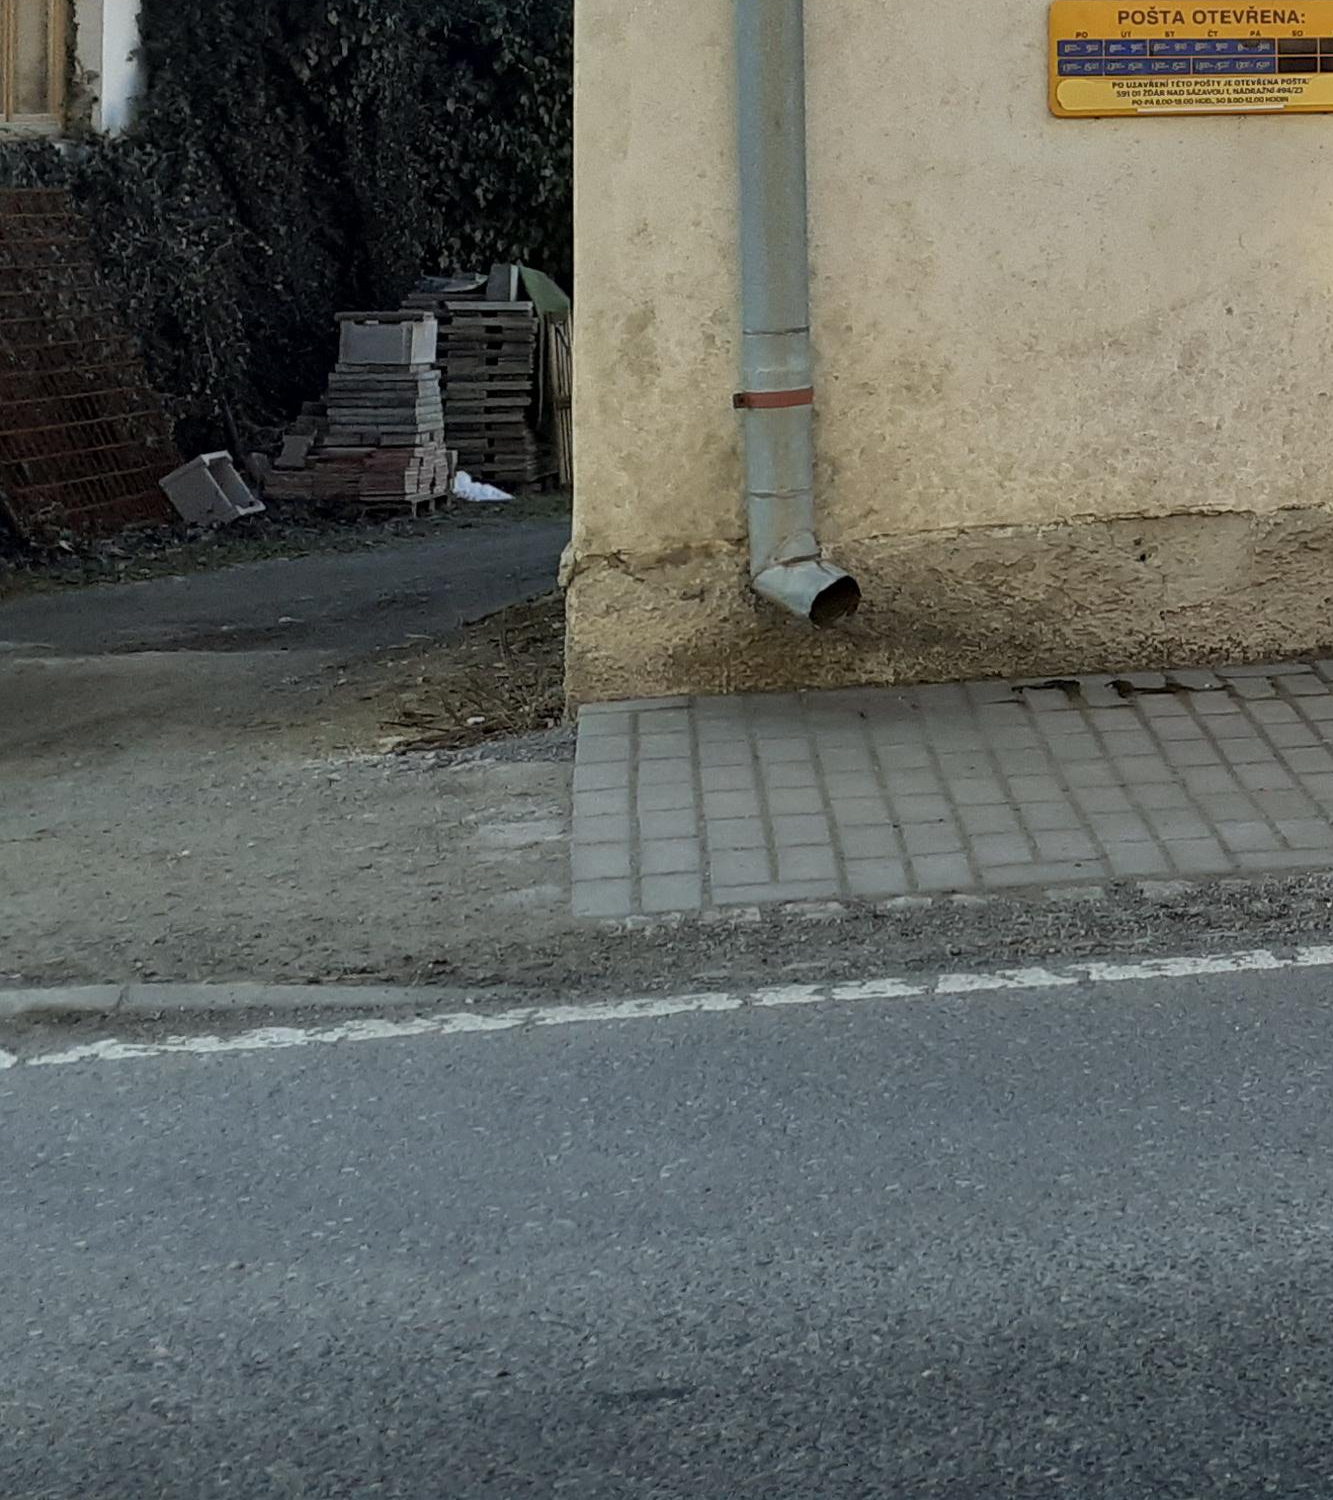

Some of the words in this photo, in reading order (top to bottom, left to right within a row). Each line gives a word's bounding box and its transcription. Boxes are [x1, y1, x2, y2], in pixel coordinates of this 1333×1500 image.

[1117, 6, 1185, 25] POŠTA
[1192, 5, 1306, 25] OTEVŘENA:
[1112, 81, 1124, 89] PO
